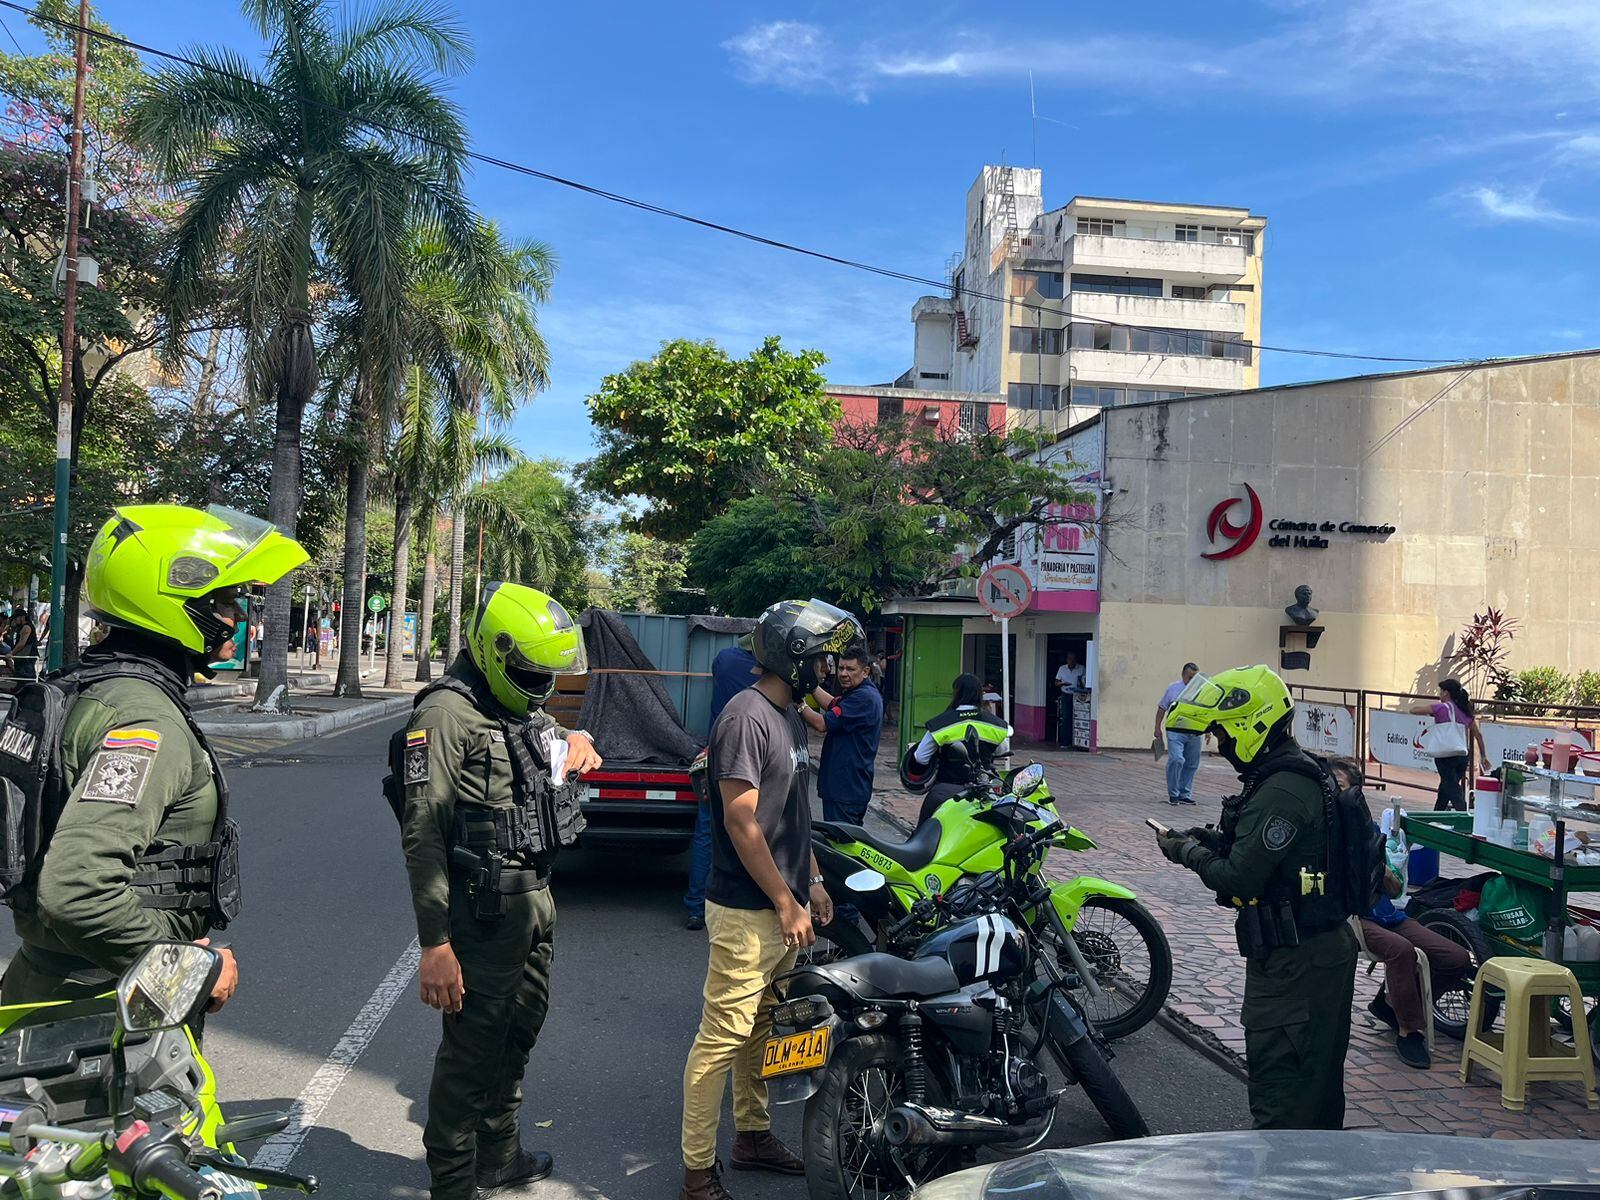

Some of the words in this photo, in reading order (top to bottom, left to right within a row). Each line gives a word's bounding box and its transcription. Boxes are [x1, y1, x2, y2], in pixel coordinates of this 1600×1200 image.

[1268, 518, 1317, 532] Cámara
[1320, 521, 1336, 532] de
[1339, 521, 1397, 534] Comercio
[1268, 535, 1291, 547] del
[1293, 535, 1329, 548] Huila
[1387, 733, 1409, 745] Edificio
[1503, 748, 1525, 761] Edifici
[860, 847, 893, 871] 65-0873
